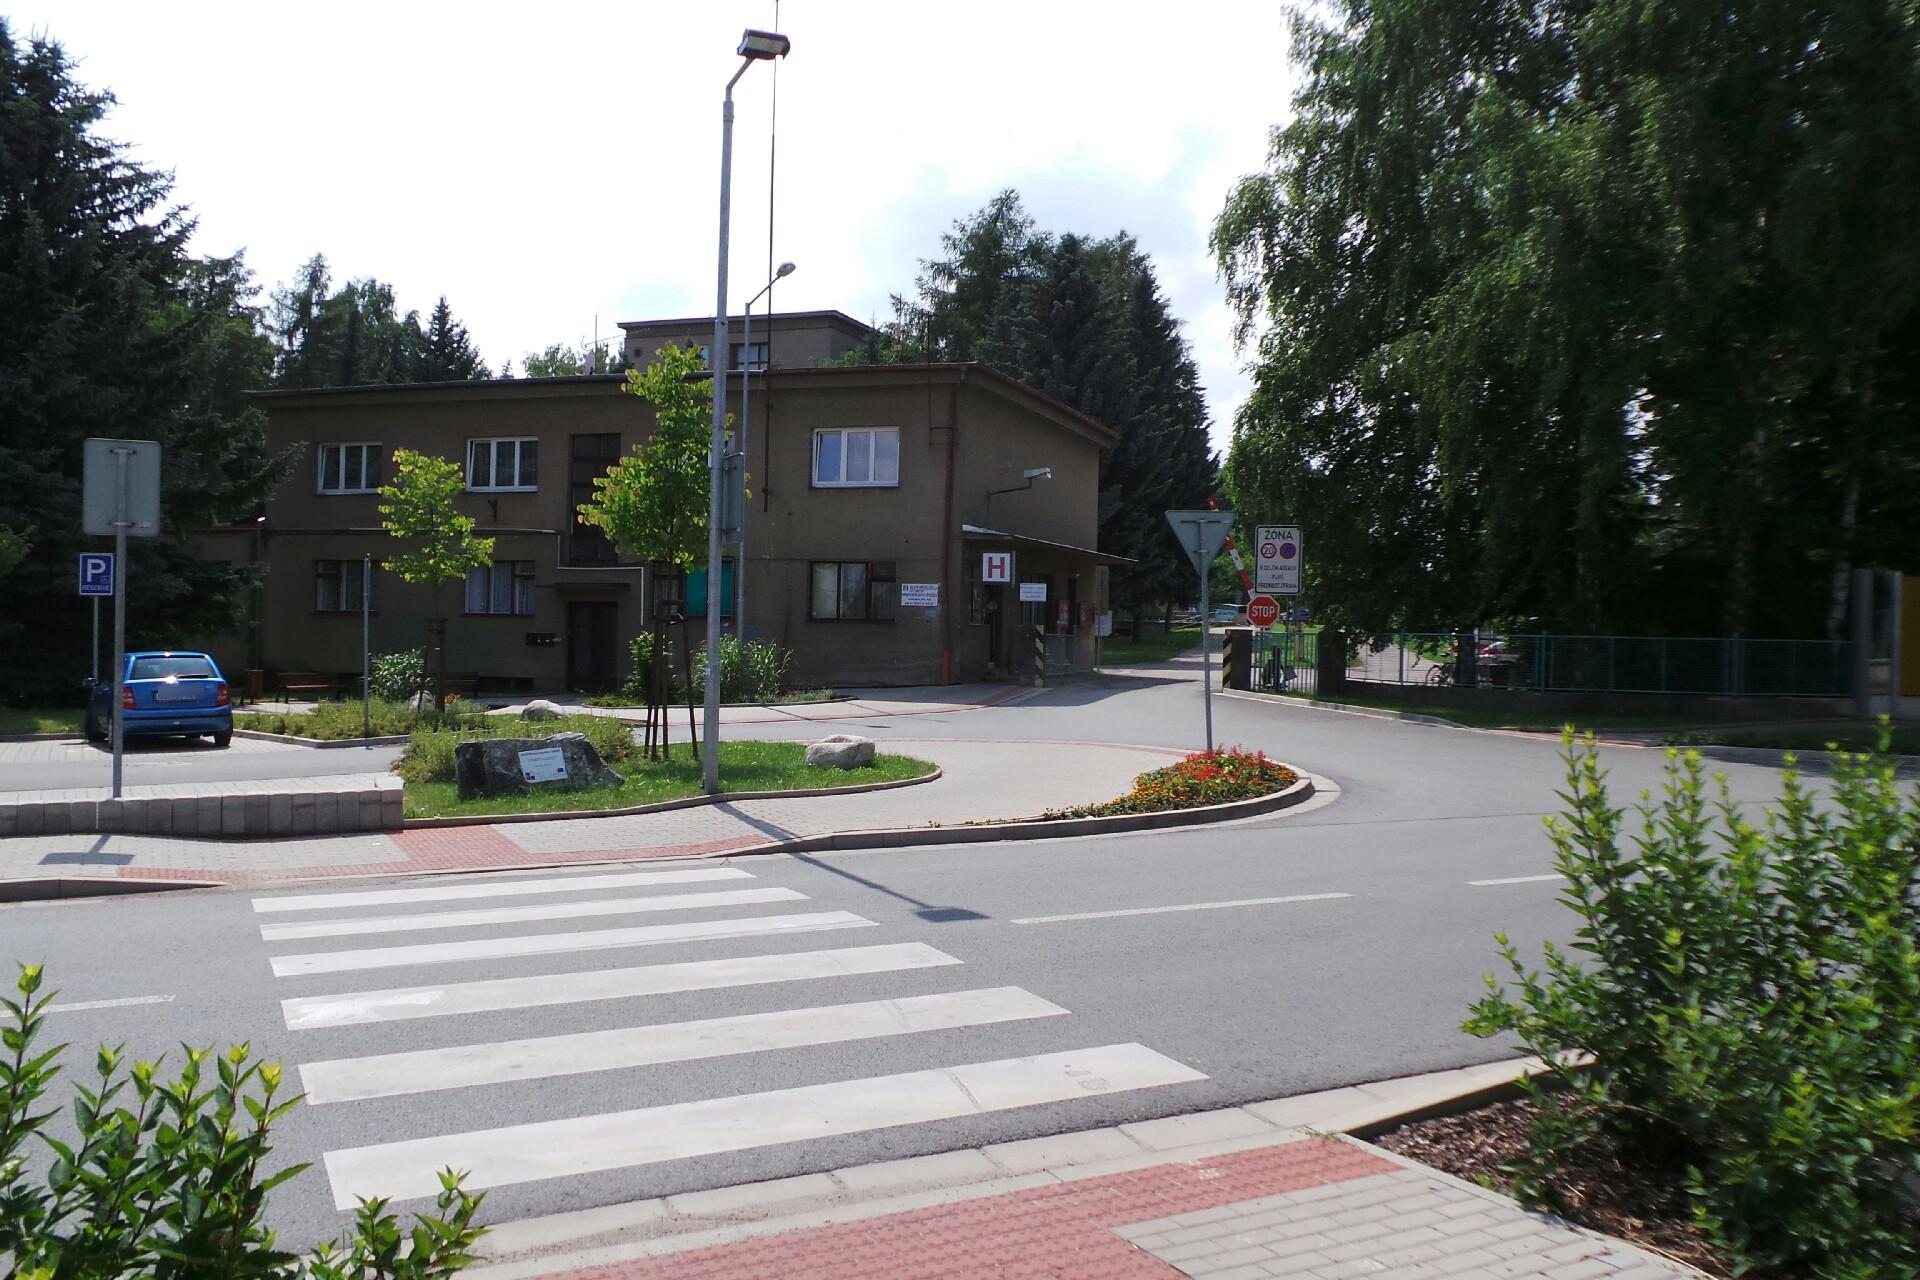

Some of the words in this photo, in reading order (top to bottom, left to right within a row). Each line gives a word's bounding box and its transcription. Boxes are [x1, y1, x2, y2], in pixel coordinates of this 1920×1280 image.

[87, 558, 106, 582] P
[987, 556, 1005, 578] H
[1252, 606, 1275, 616] STOP
